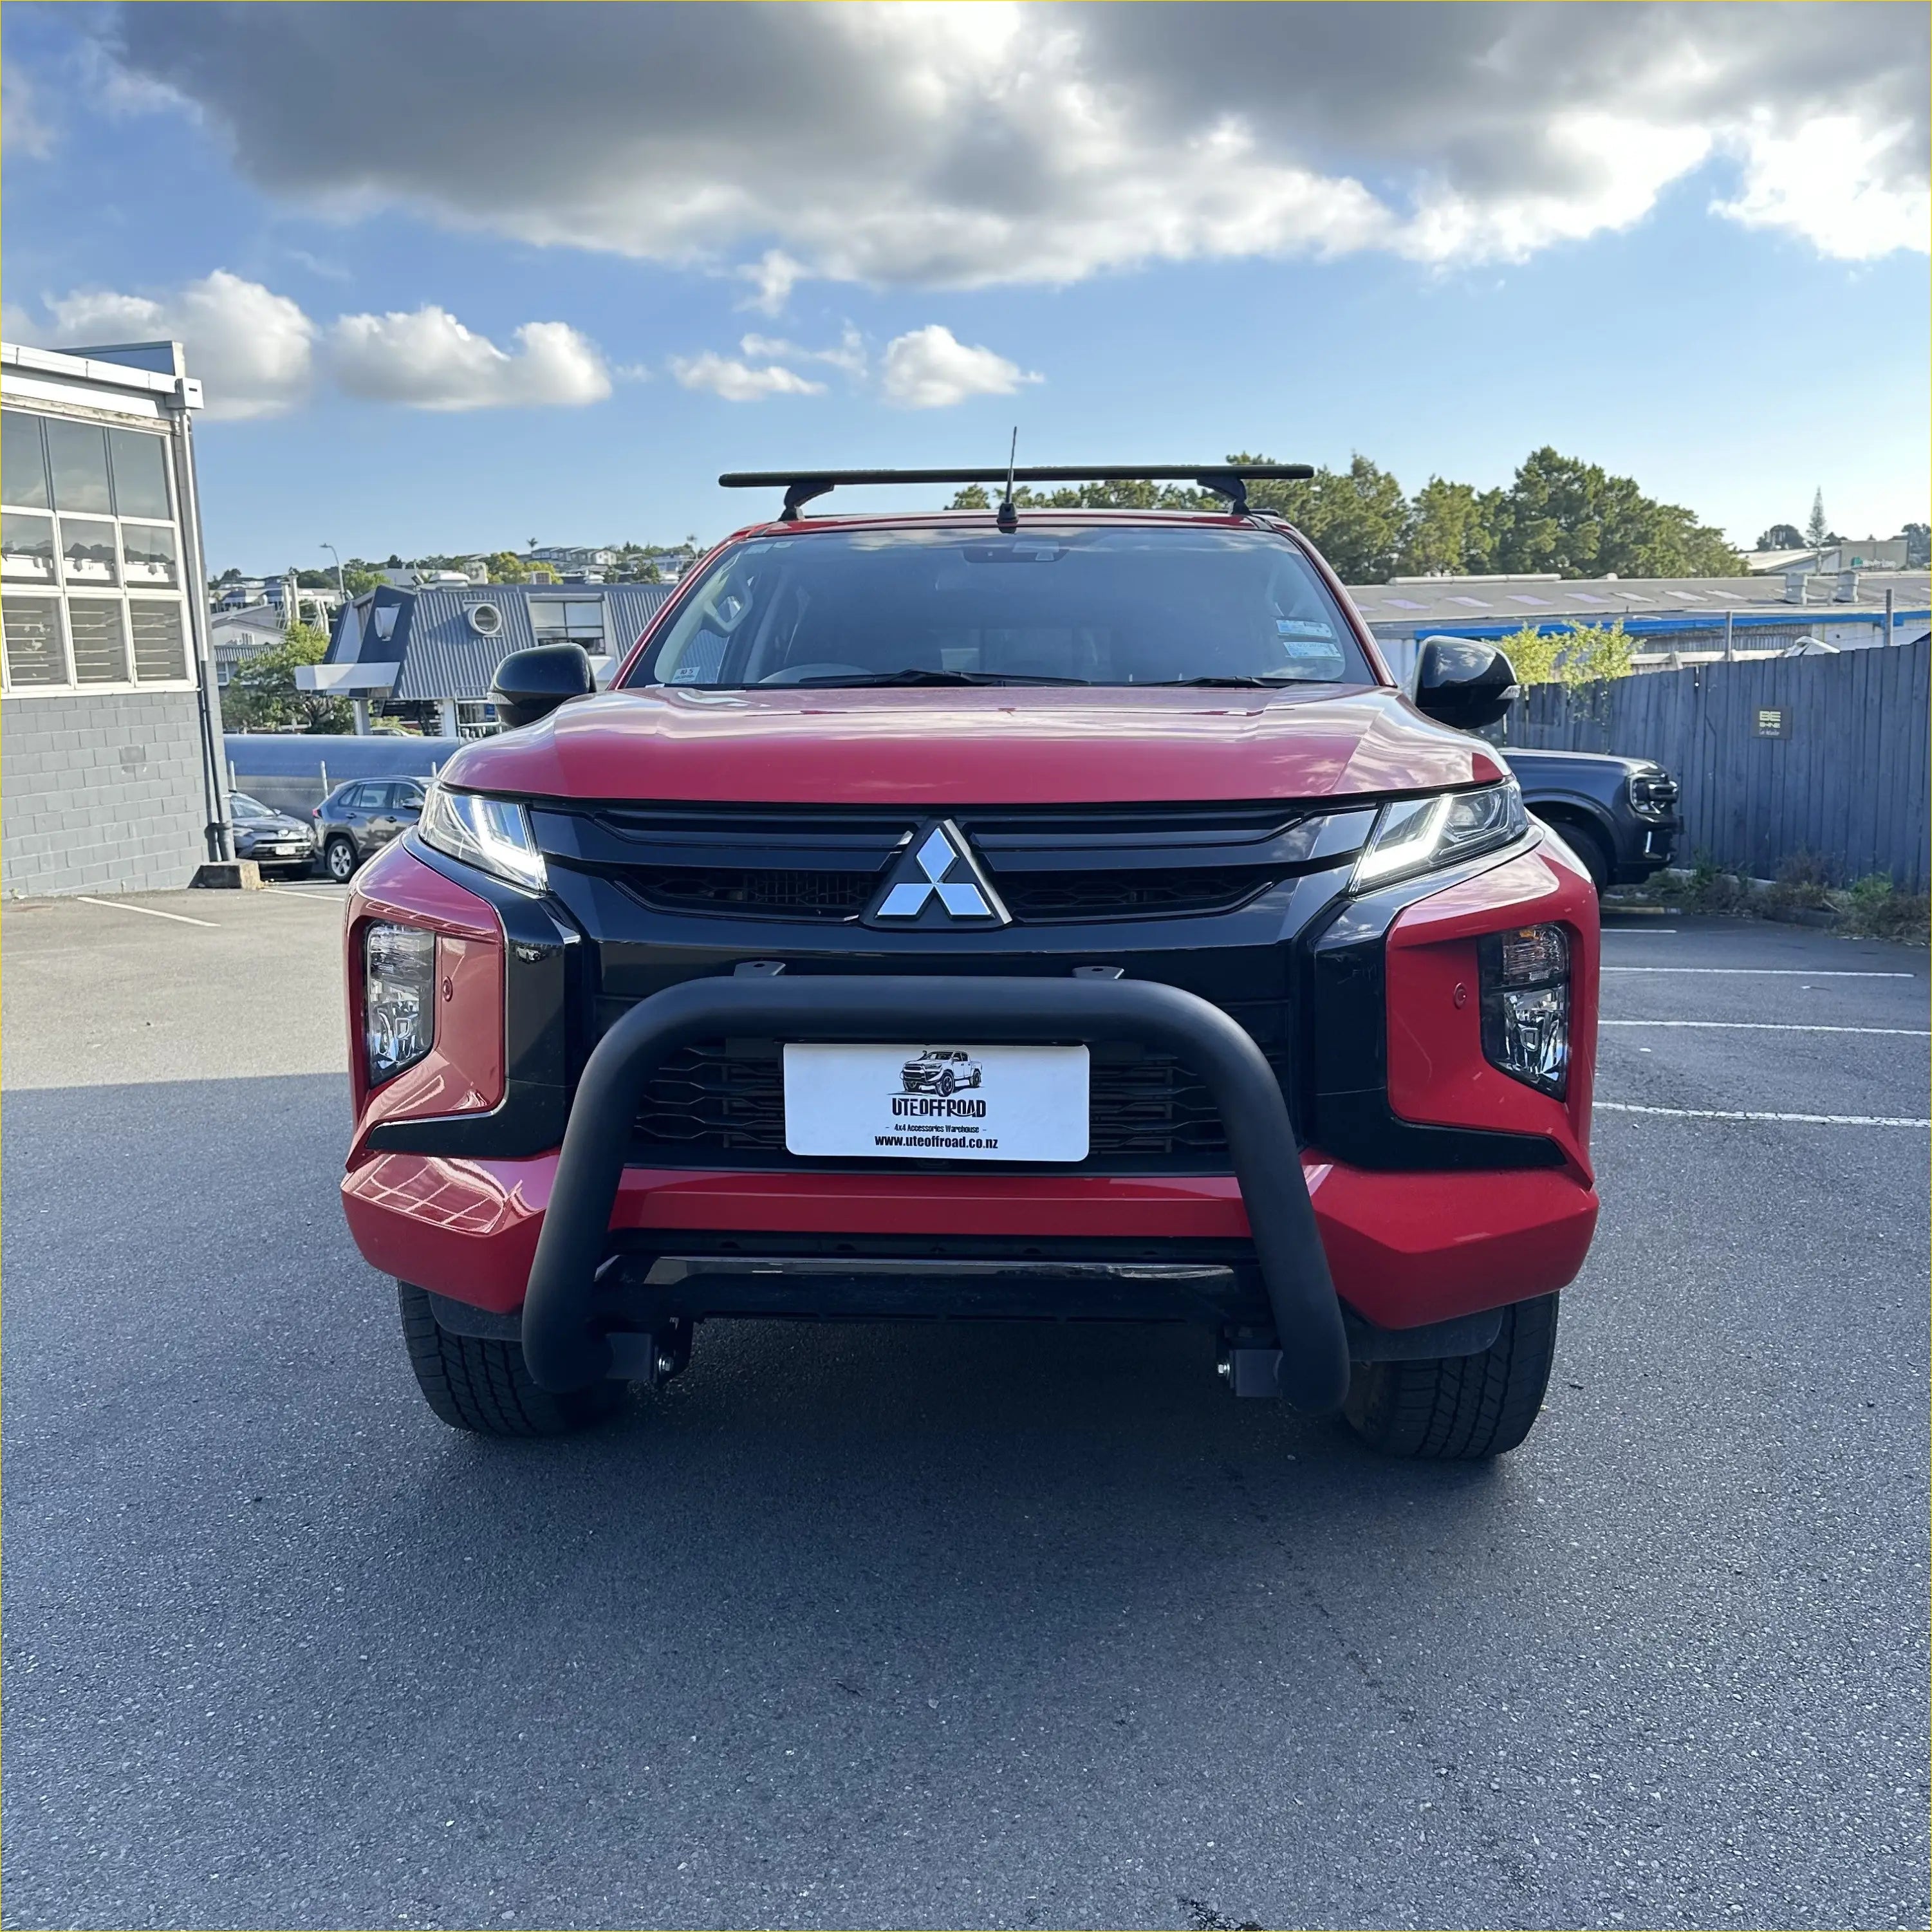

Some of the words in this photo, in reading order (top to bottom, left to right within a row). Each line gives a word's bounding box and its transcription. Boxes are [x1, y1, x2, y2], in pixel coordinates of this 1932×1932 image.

[892, 1097, 987, 1118] UTEOFFROAD
[945, 1125, 980, 1133] Warehouse
[874, 1135, 998, 1149] www.uteoffroad.co.nz
